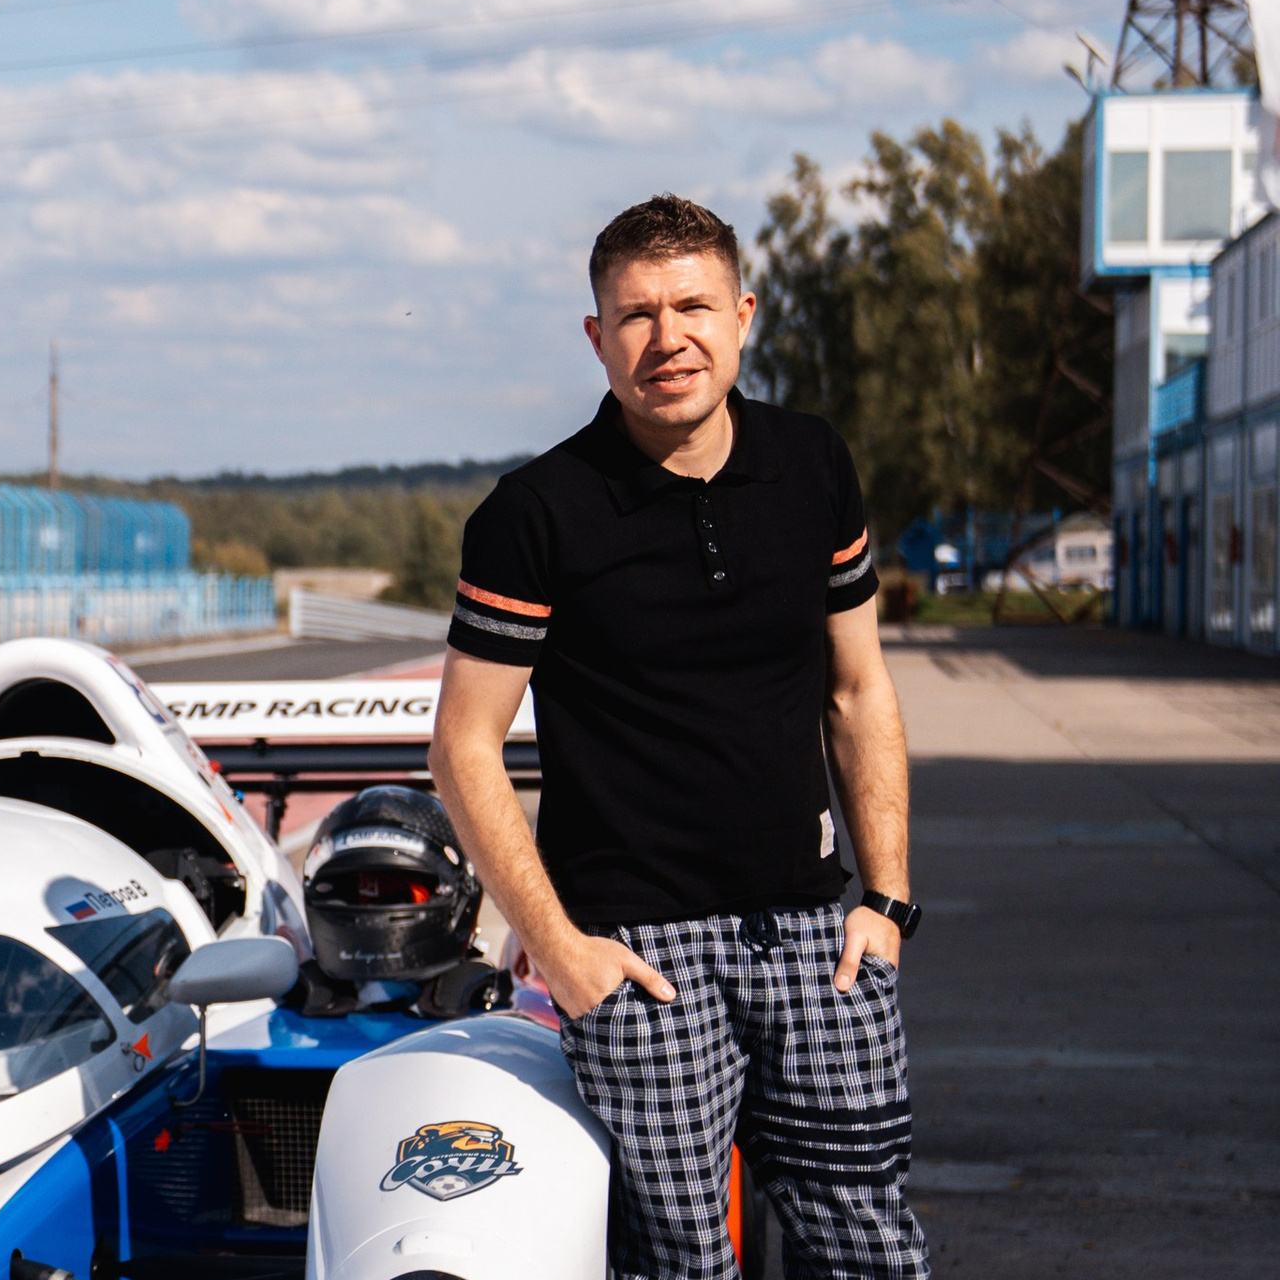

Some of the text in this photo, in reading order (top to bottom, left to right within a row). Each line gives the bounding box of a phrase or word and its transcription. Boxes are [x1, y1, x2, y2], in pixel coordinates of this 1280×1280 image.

[166, 697, 433, 719] SMP RACING
[84, 887, 138, 910] Петров
